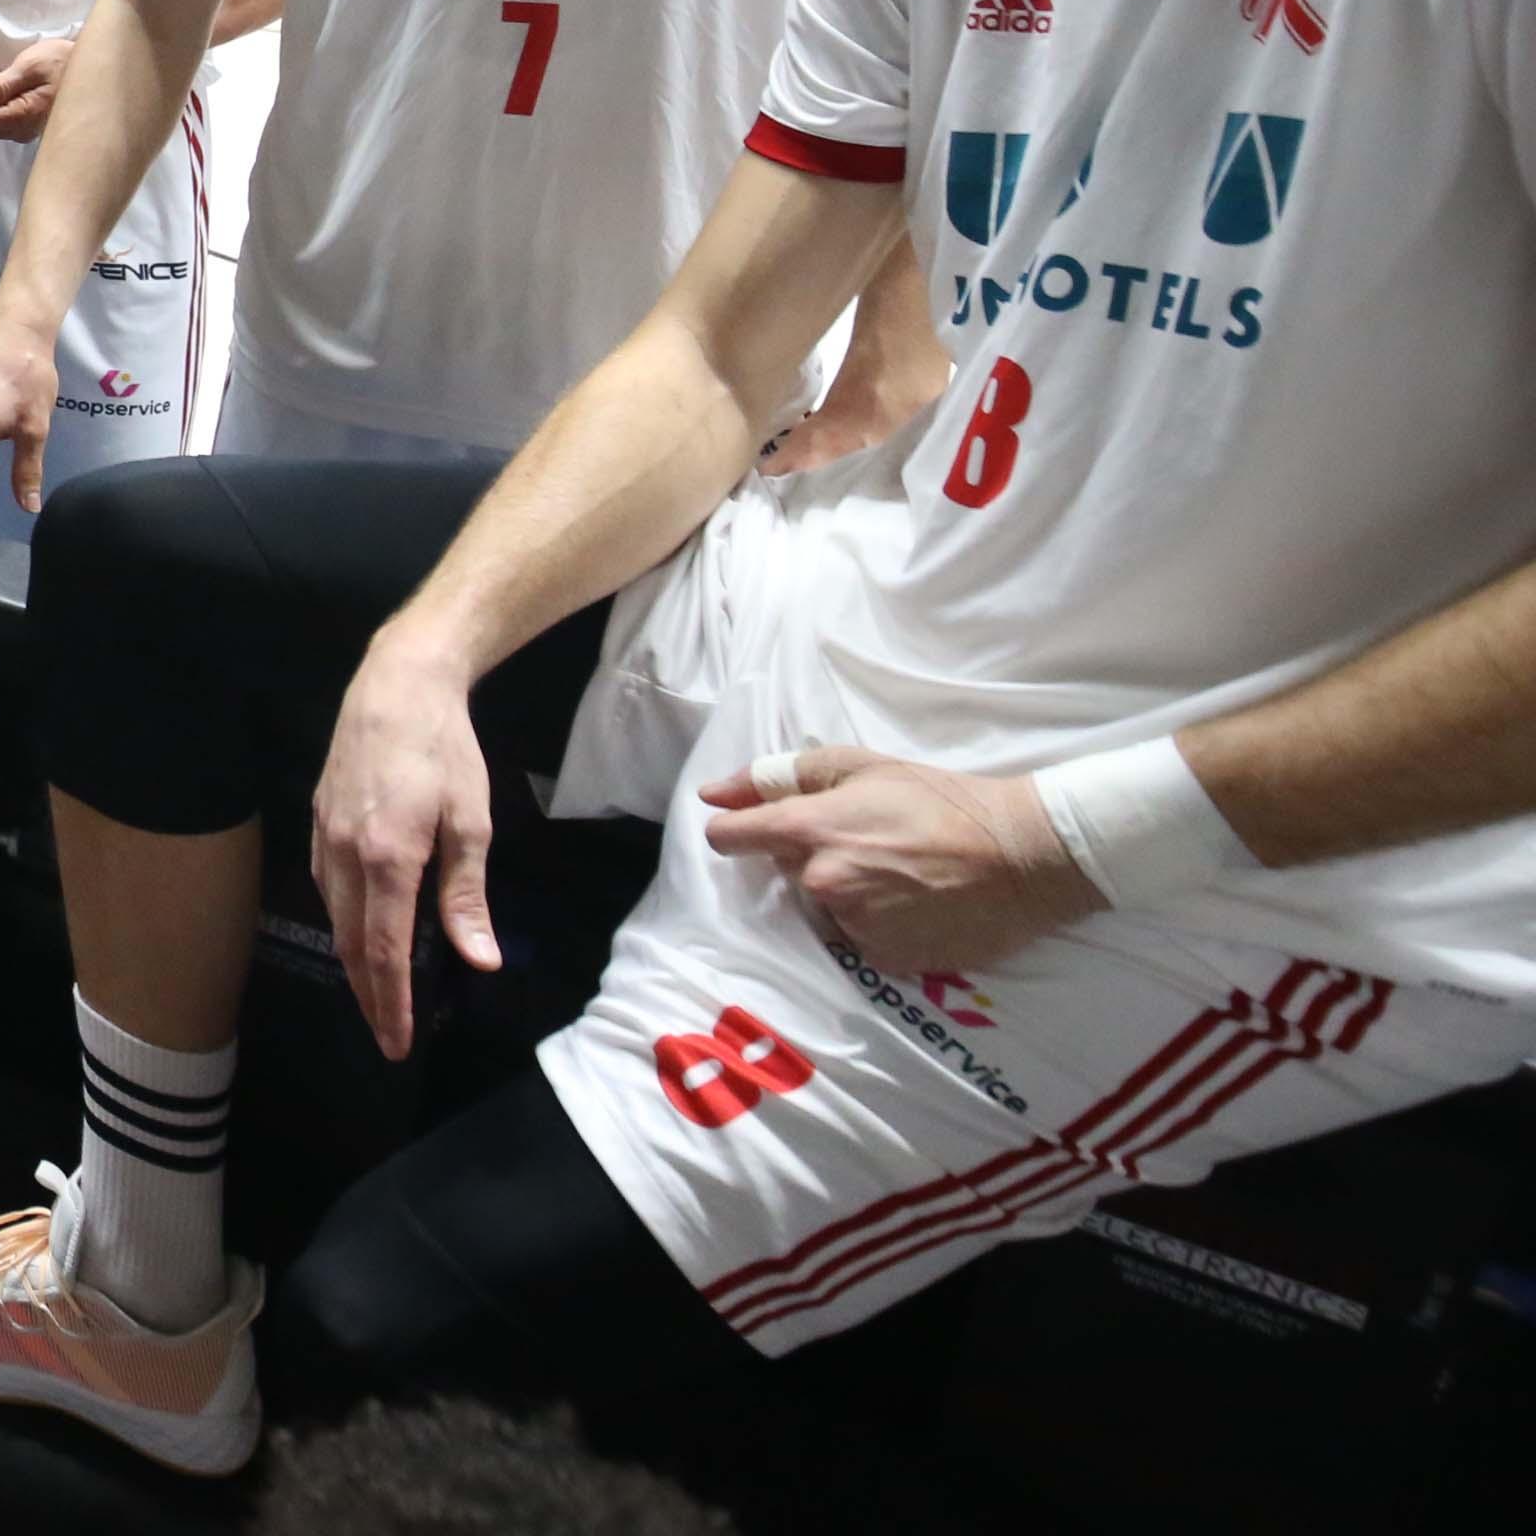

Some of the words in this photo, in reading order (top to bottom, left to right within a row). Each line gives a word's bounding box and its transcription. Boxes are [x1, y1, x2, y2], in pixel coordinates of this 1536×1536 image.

[501, 0, 560, 117] 7
[55, 396, 171, 418] coopservice
[826, 940, 1029, 1116] coopservice
